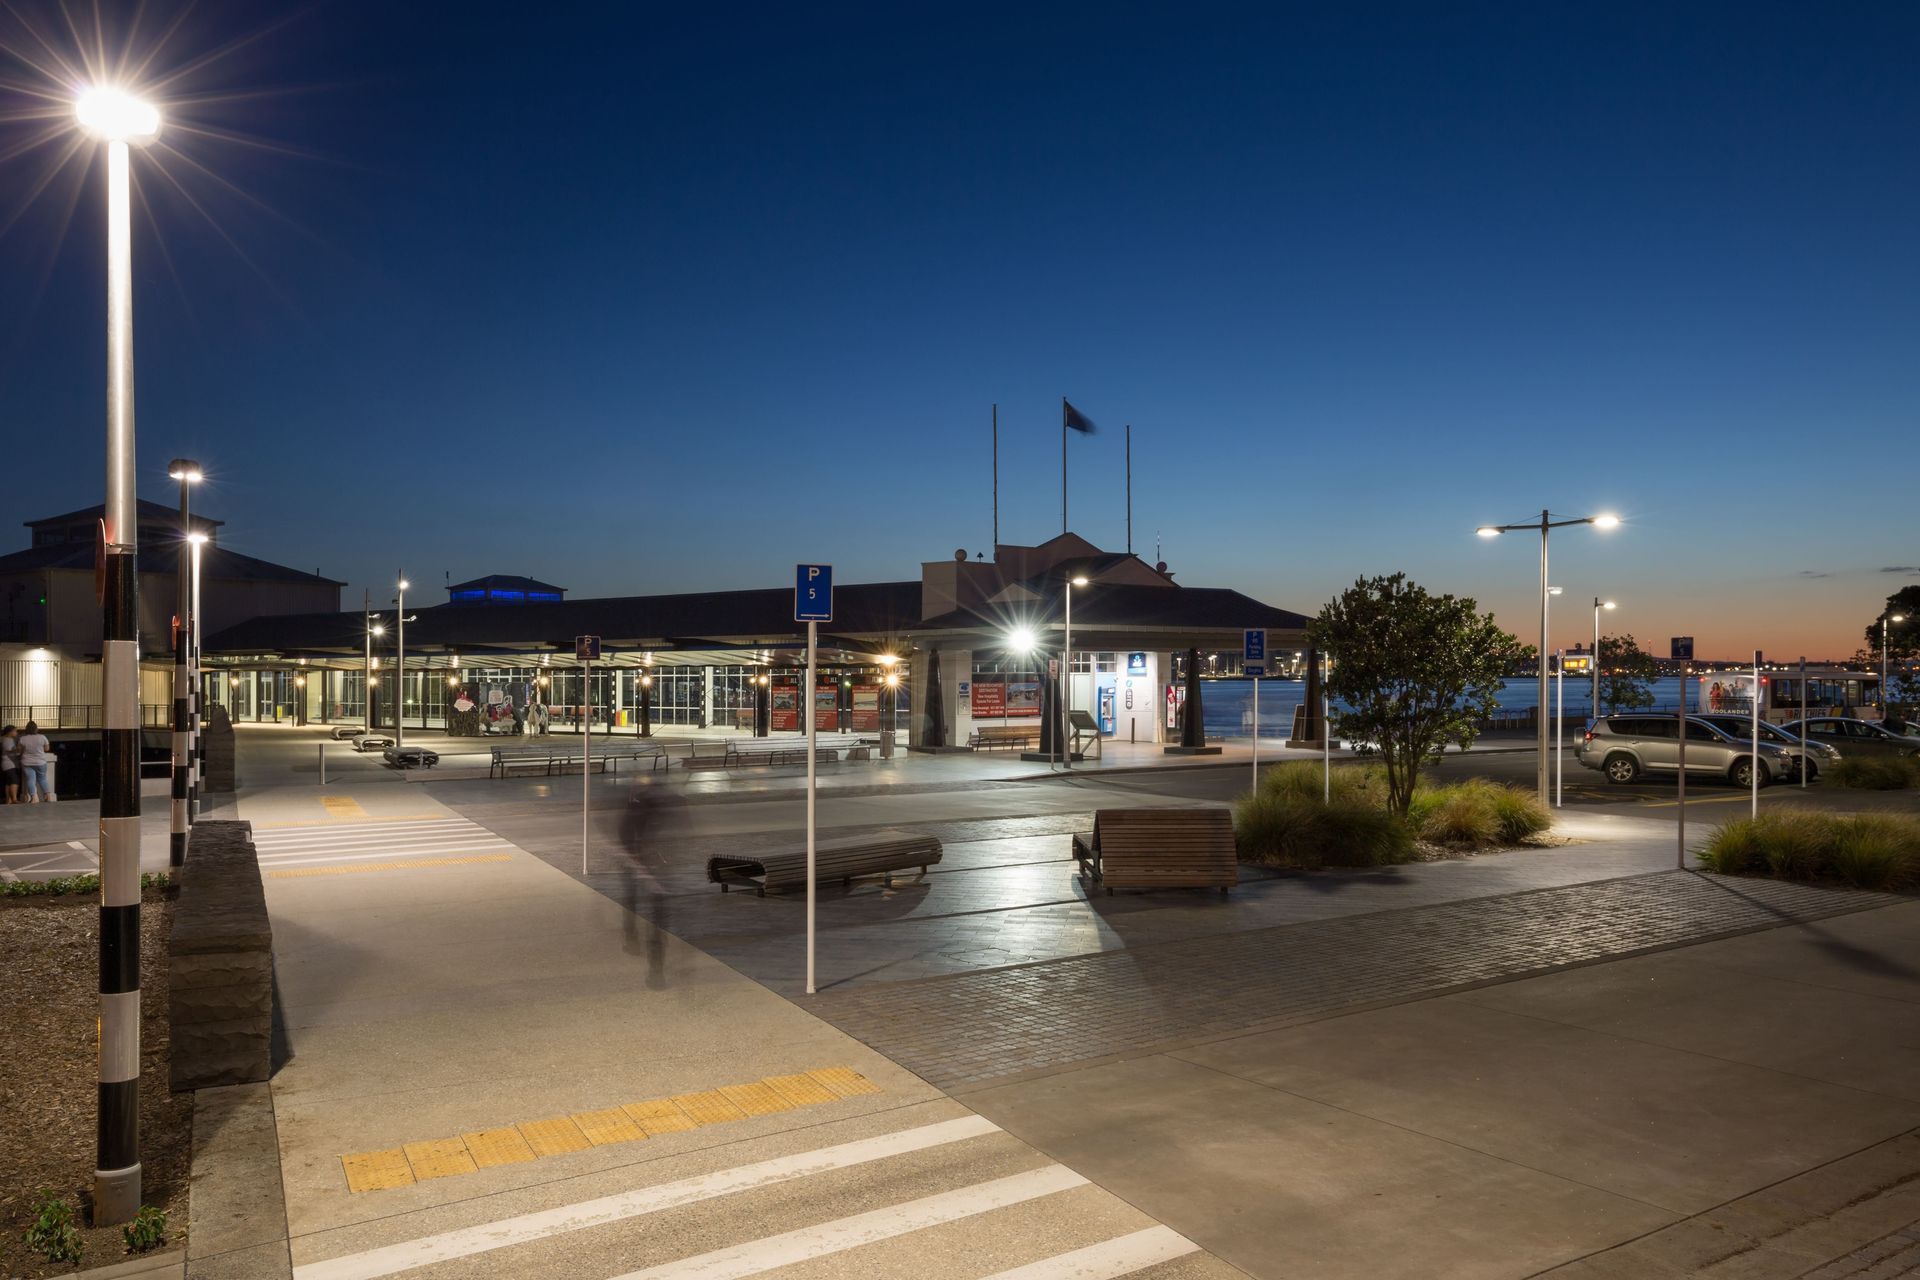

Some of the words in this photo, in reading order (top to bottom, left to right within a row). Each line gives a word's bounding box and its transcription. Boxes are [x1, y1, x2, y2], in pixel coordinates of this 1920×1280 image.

[809, 567, 820, 581] P
[809, 588, 816, 599] 5
[584, 637, 592, 647] P
[1793, 708, 1826, 719] RICHIES
